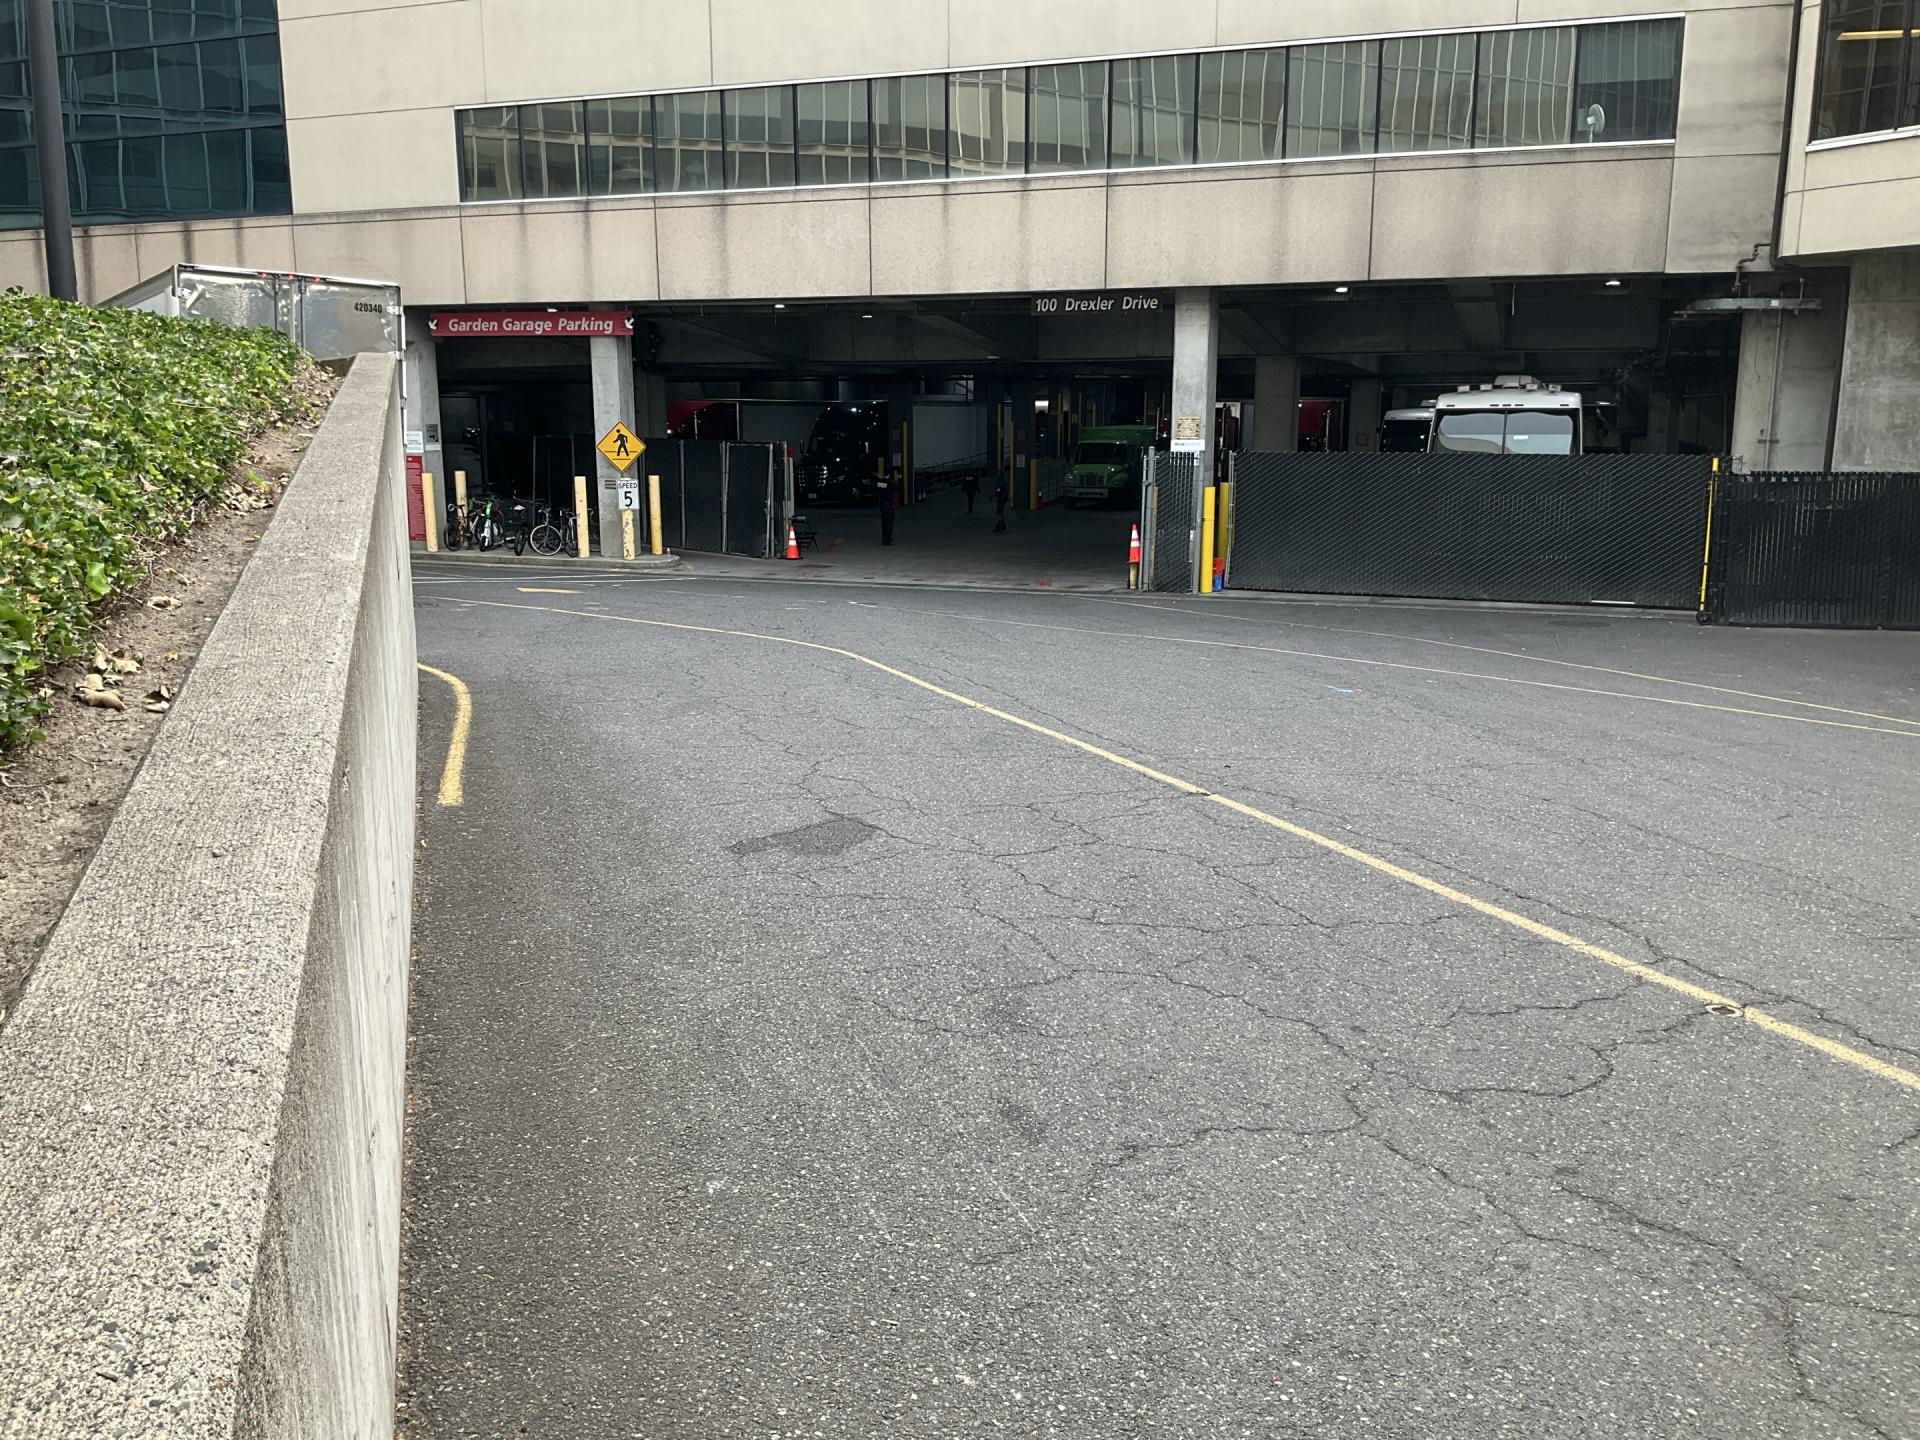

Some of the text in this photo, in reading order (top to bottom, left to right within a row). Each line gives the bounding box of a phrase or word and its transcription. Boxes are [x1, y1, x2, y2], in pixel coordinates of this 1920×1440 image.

[354, 302, 383, 314] 420340
[1035, 295, 1159, 312] 100 Drexler Drive
[448, 317, 614, 334] Garden Garage Parking
[624, 490, 633, 507] 5
